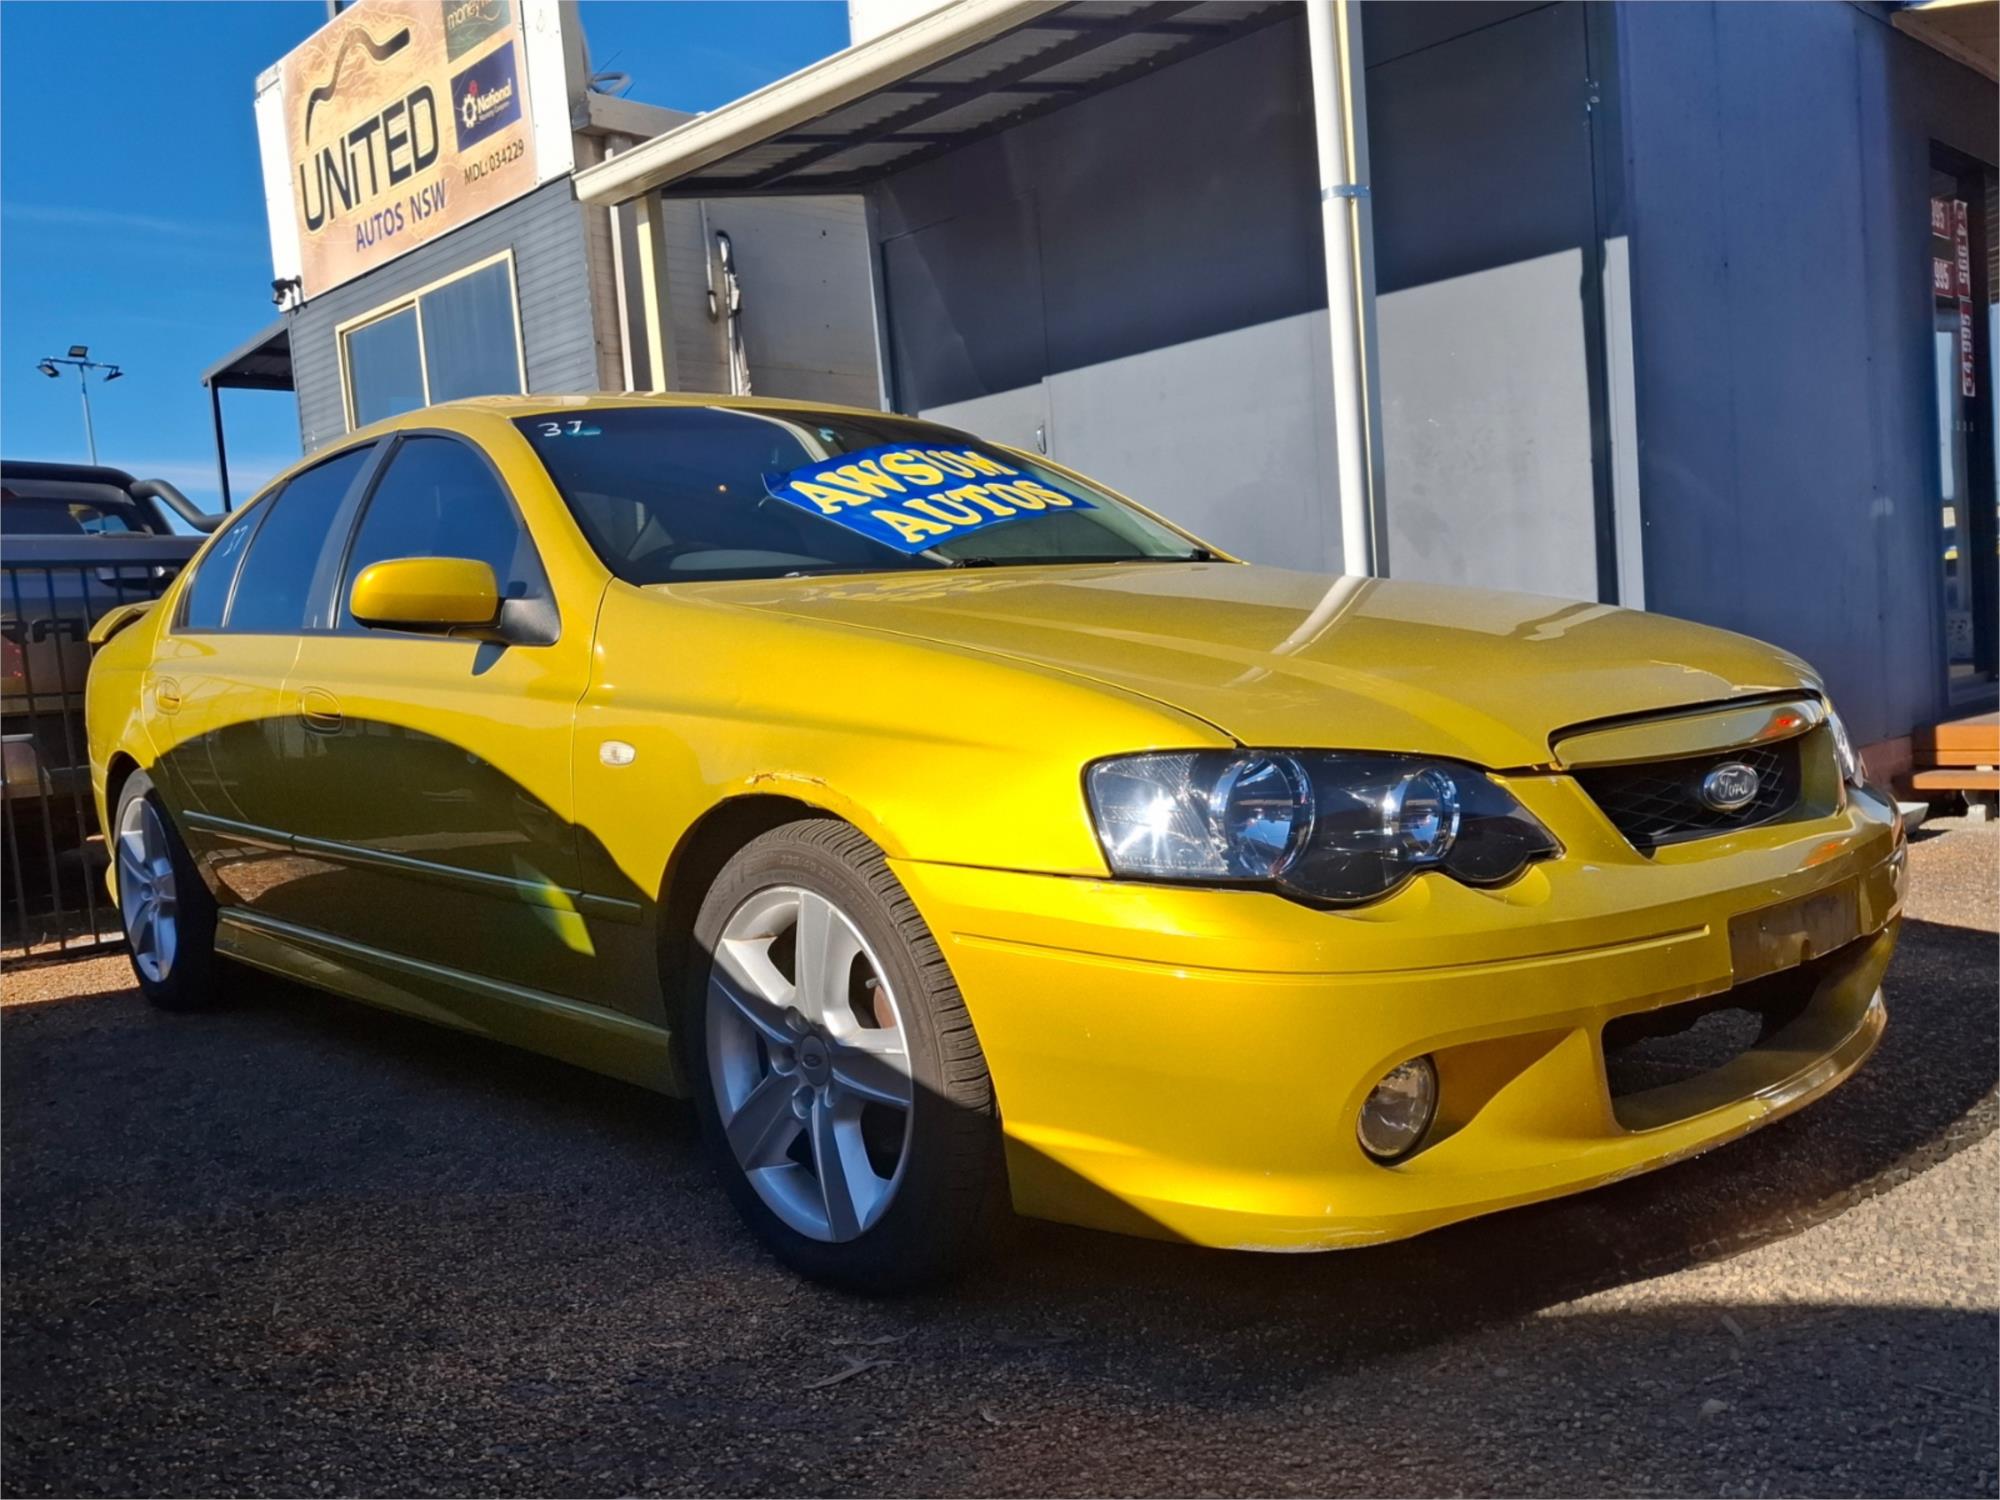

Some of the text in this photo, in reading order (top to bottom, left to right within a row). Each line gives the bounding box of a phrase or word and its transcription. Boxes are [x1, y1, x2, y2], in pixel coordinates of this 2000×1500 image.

[477, 78, 512, 113] National
[300, 84, 439, 231] UNITED
[356, 178, 448, 252] AUTOS NSW
[790, 449, 1020, 514] AWSUM
[871, 480, 1073, 543] AUTOS
[1719, 770, 1749, 799] Ford
